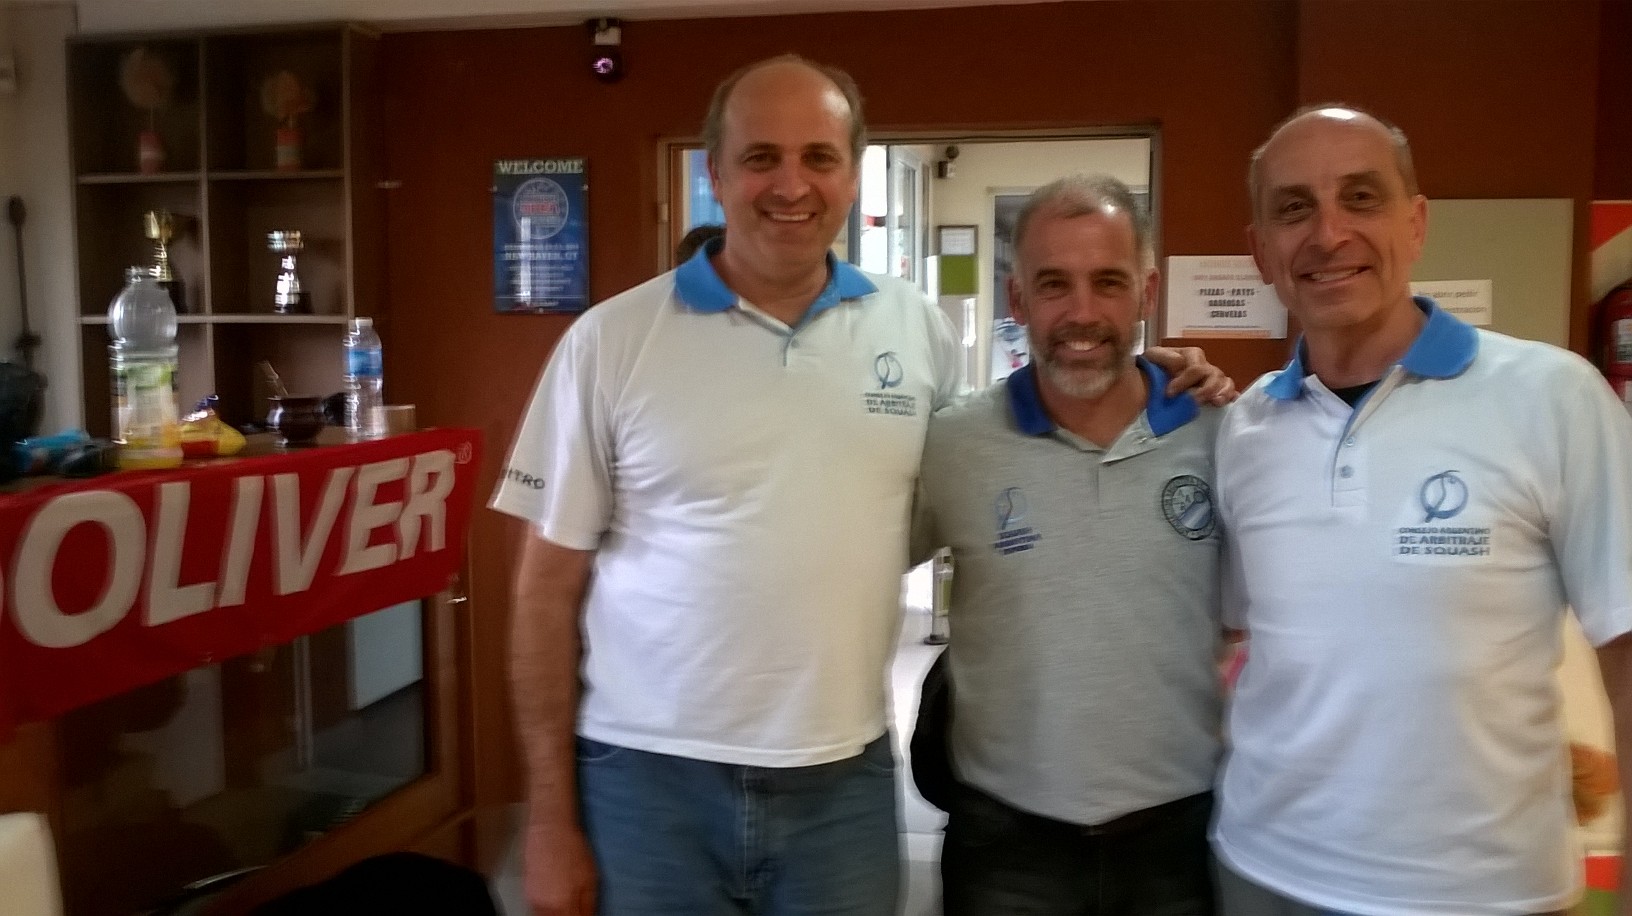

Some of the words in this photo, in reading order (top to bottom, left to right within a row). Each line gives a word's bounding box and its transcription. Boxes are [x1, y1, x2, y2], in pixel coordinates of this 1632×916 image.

[498, 160, 583, 174] WELCOME
[1200, 288, 1225, 296] PIZZAS
[1210, 310, 1248, 318] CERVEZAS
[1399, 536, 1419, 544] DE
[1420, 536, 1491, 545] ARBITRAJE
[13, 449, 456, 649] OLIVER
[1399, 546, 1420, 555] DE
[1424, 546, 1491, 556] SQUASH
